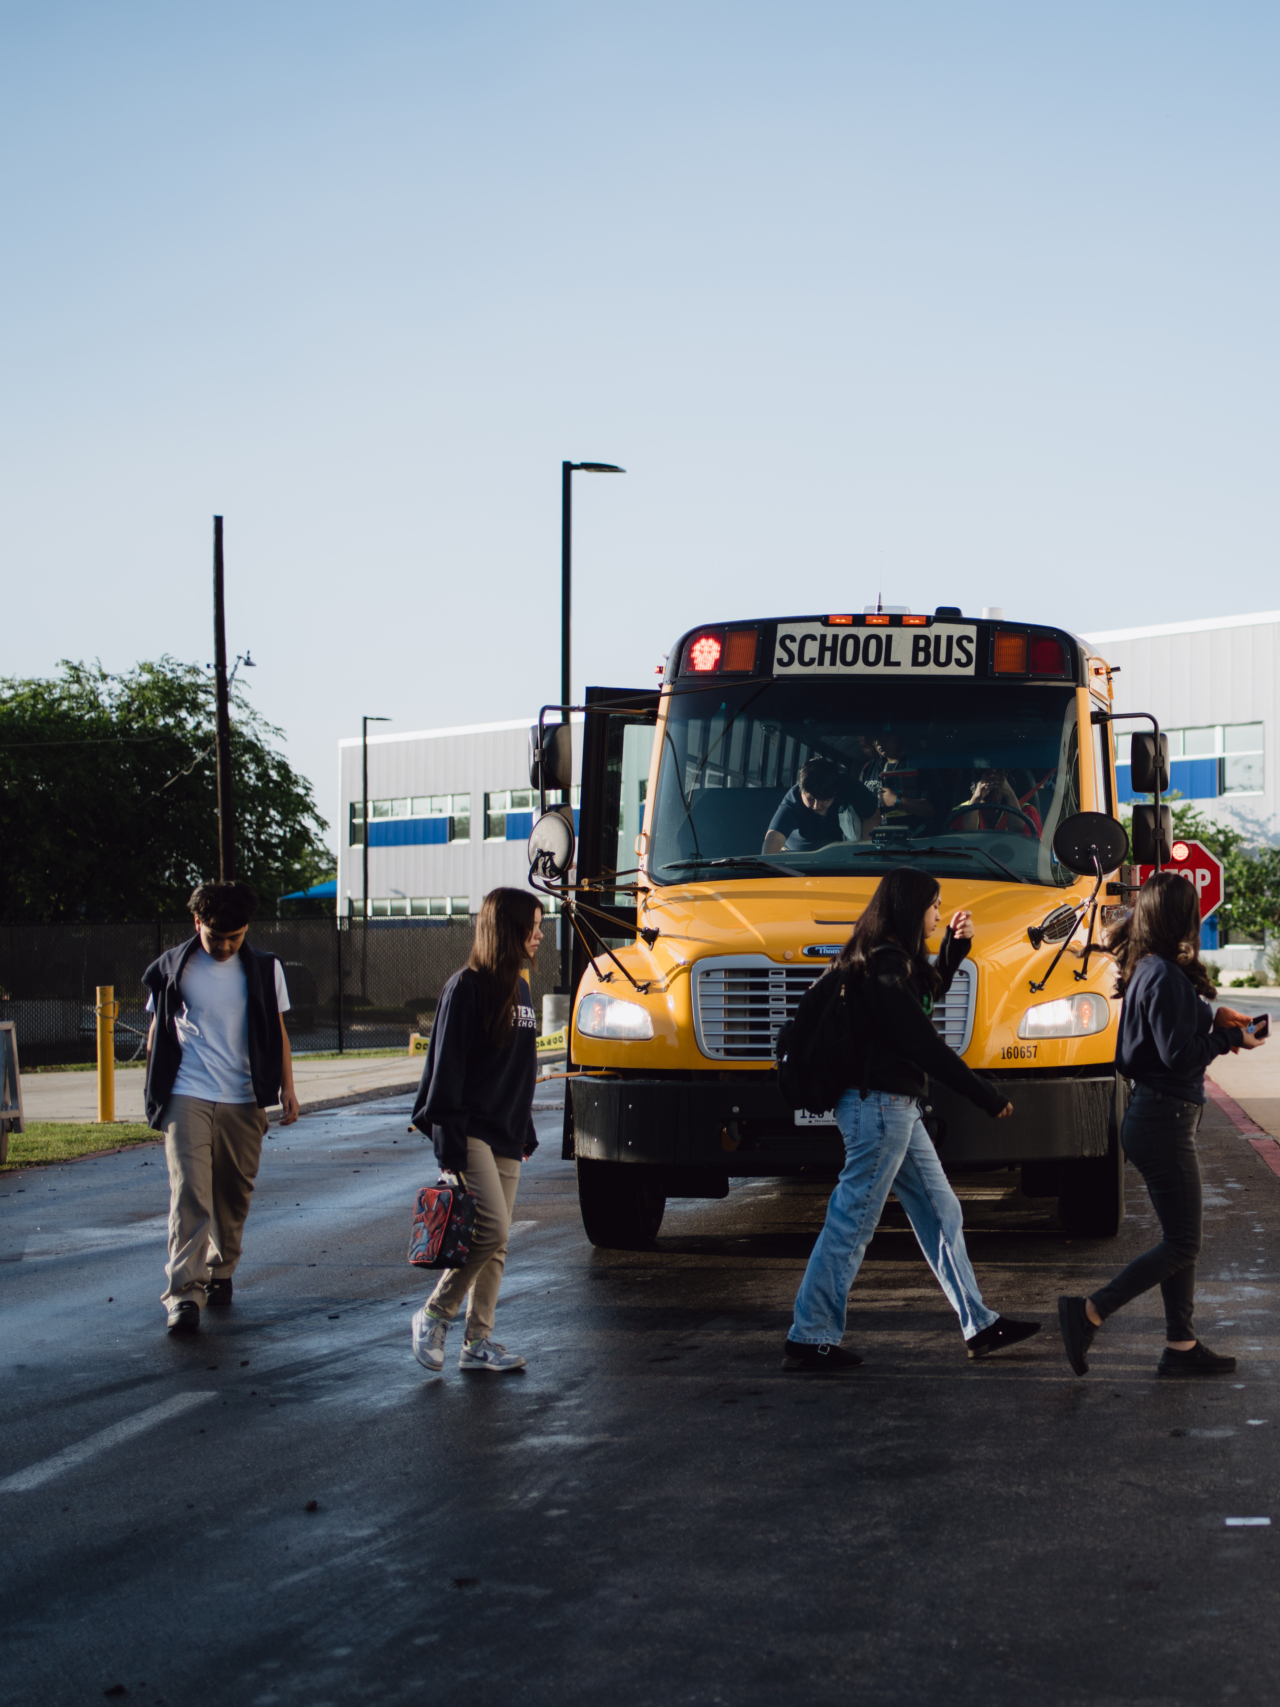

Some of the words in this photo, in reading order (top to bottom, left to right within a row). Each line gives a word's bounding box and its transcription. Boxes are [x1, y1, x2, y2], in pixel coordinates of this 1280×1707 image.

[776, 633, 901, 668] SCHOOL
[911, 634, 975, 668] BUS
[815, 946, 840, 954] Thom
[1001, 1045, 1038, 1060] 160657
